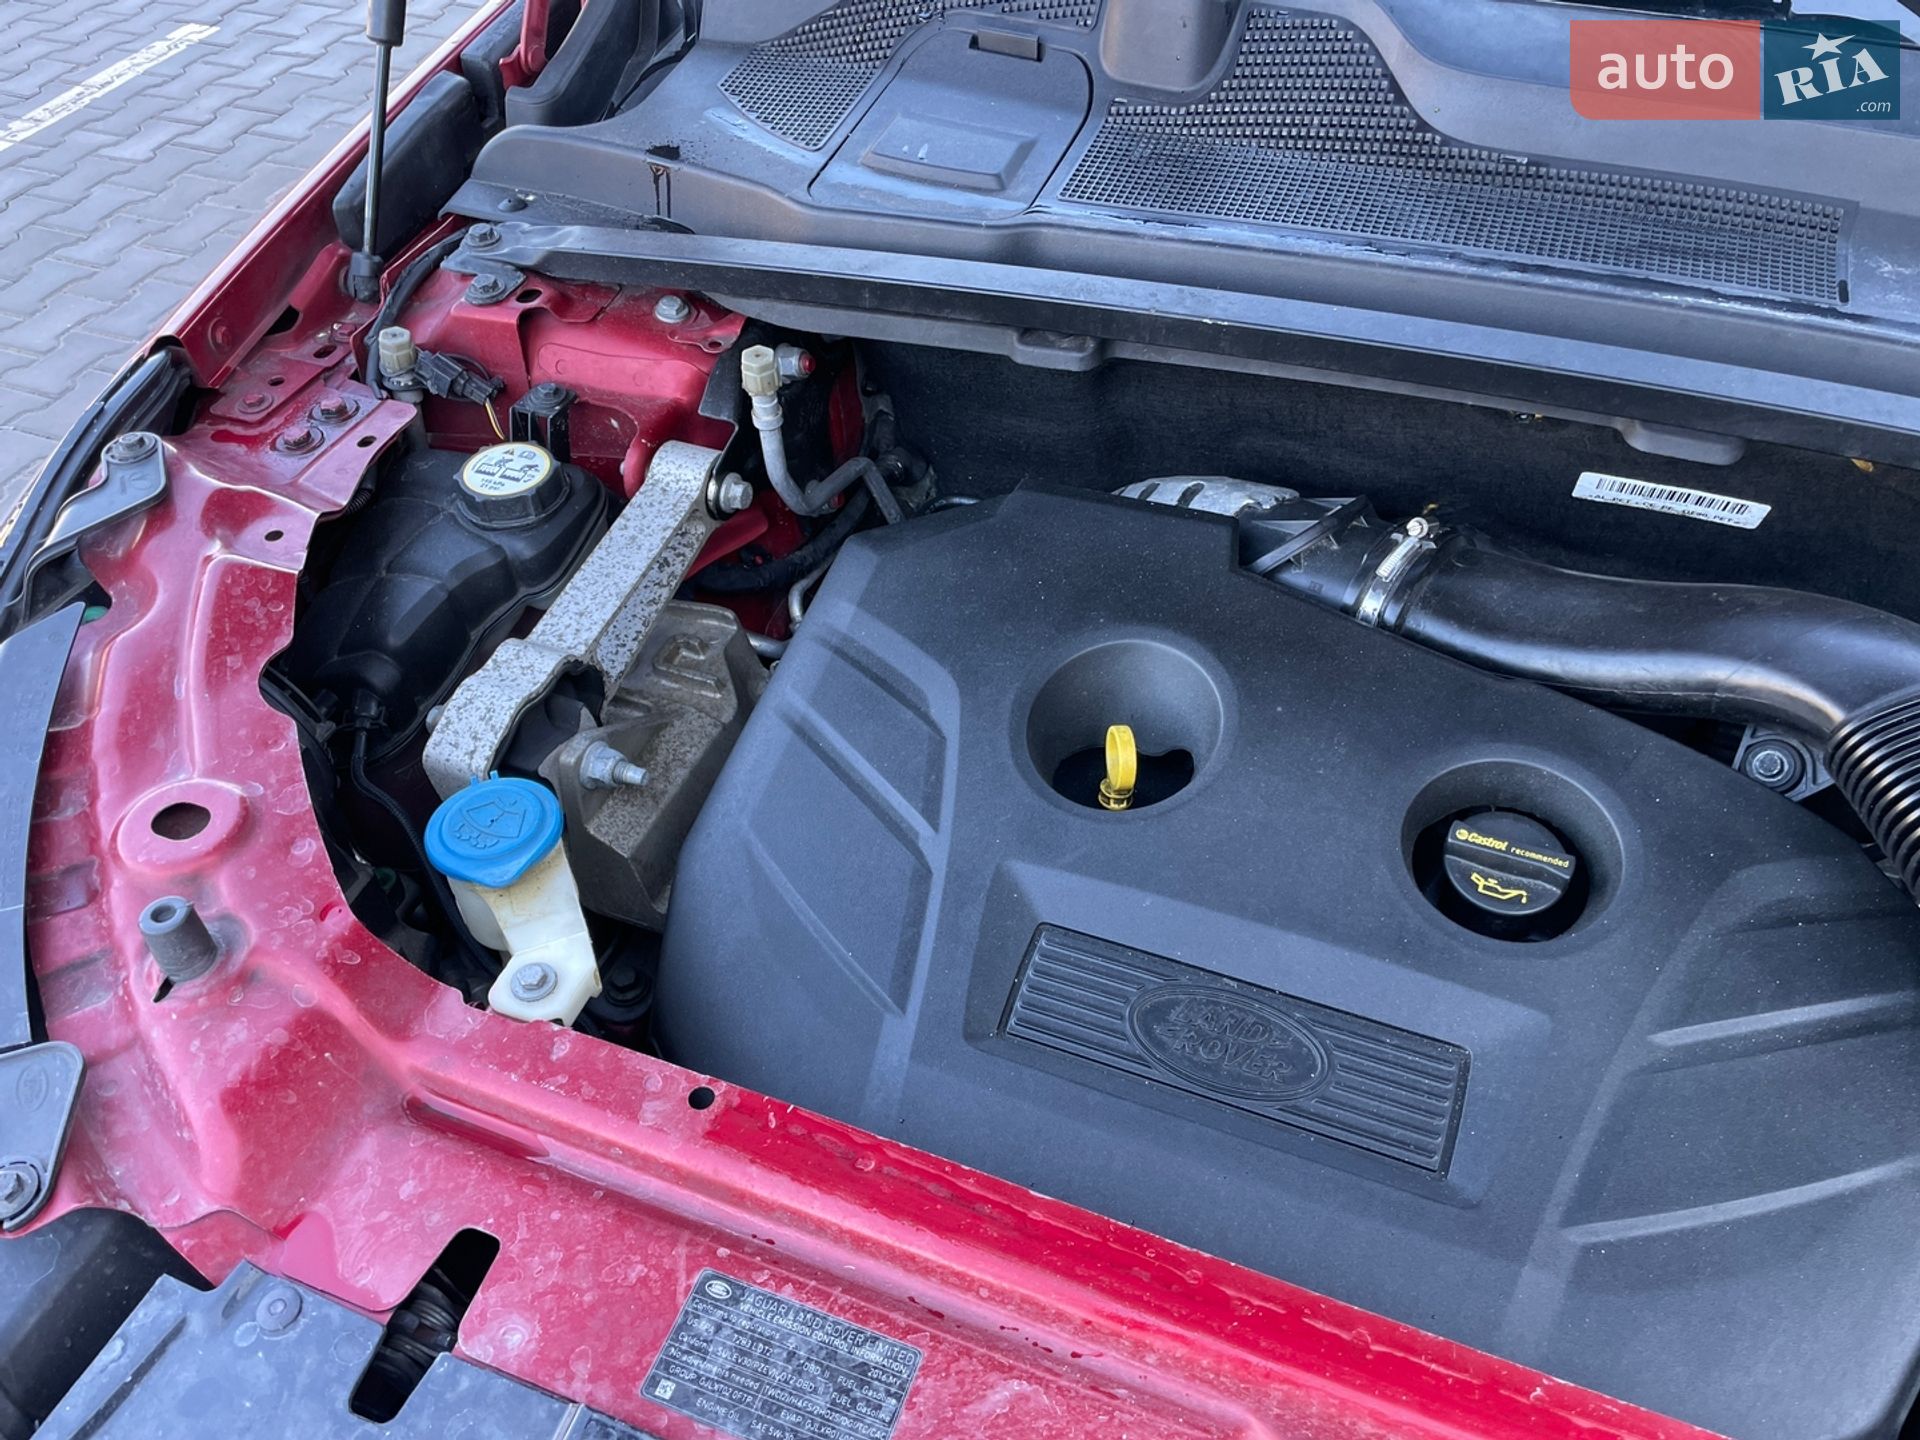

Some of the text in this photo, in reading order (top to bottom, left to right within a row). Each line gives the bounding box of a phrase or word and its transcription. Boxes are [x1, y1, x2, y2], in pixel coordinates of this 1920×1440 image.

[1467, 832, 1570, 868] Castrol recommended
[1169, 998, 1270, 1044] LAND
[1173, 1030, 1292, 1083] ROVER
[691, 1298, 729, 1319] Conforms
[737, 1301, 773, 1321] VEHICLE
[772, 1315, 812, 1336] EMISSION
[810, 1330, 850, 1351] CONTROL
[739, 1289, 788, 1316] JAGUAR
[786, 1307, 823, 1330] LAND
[823, 1321, 864, 1346] ROVER
[864, 1337, 916, 1366] LIMITED
[667, 1364, 697, 1382] GROUP
[779, 1409, 803, 1424] EVAP
[728, 1371, 760, 1390] needed
[835, 1375, 860, 1391] FUEL
[695, 1396, 728, 1416] ENGINE
[726, 1409, 742, 1422] OIL
[749, 1418, 768, 1432] SAE
[829, 1391, 854, 1407] FUEL
[854, 1401, 892, 1422] Gasoline
